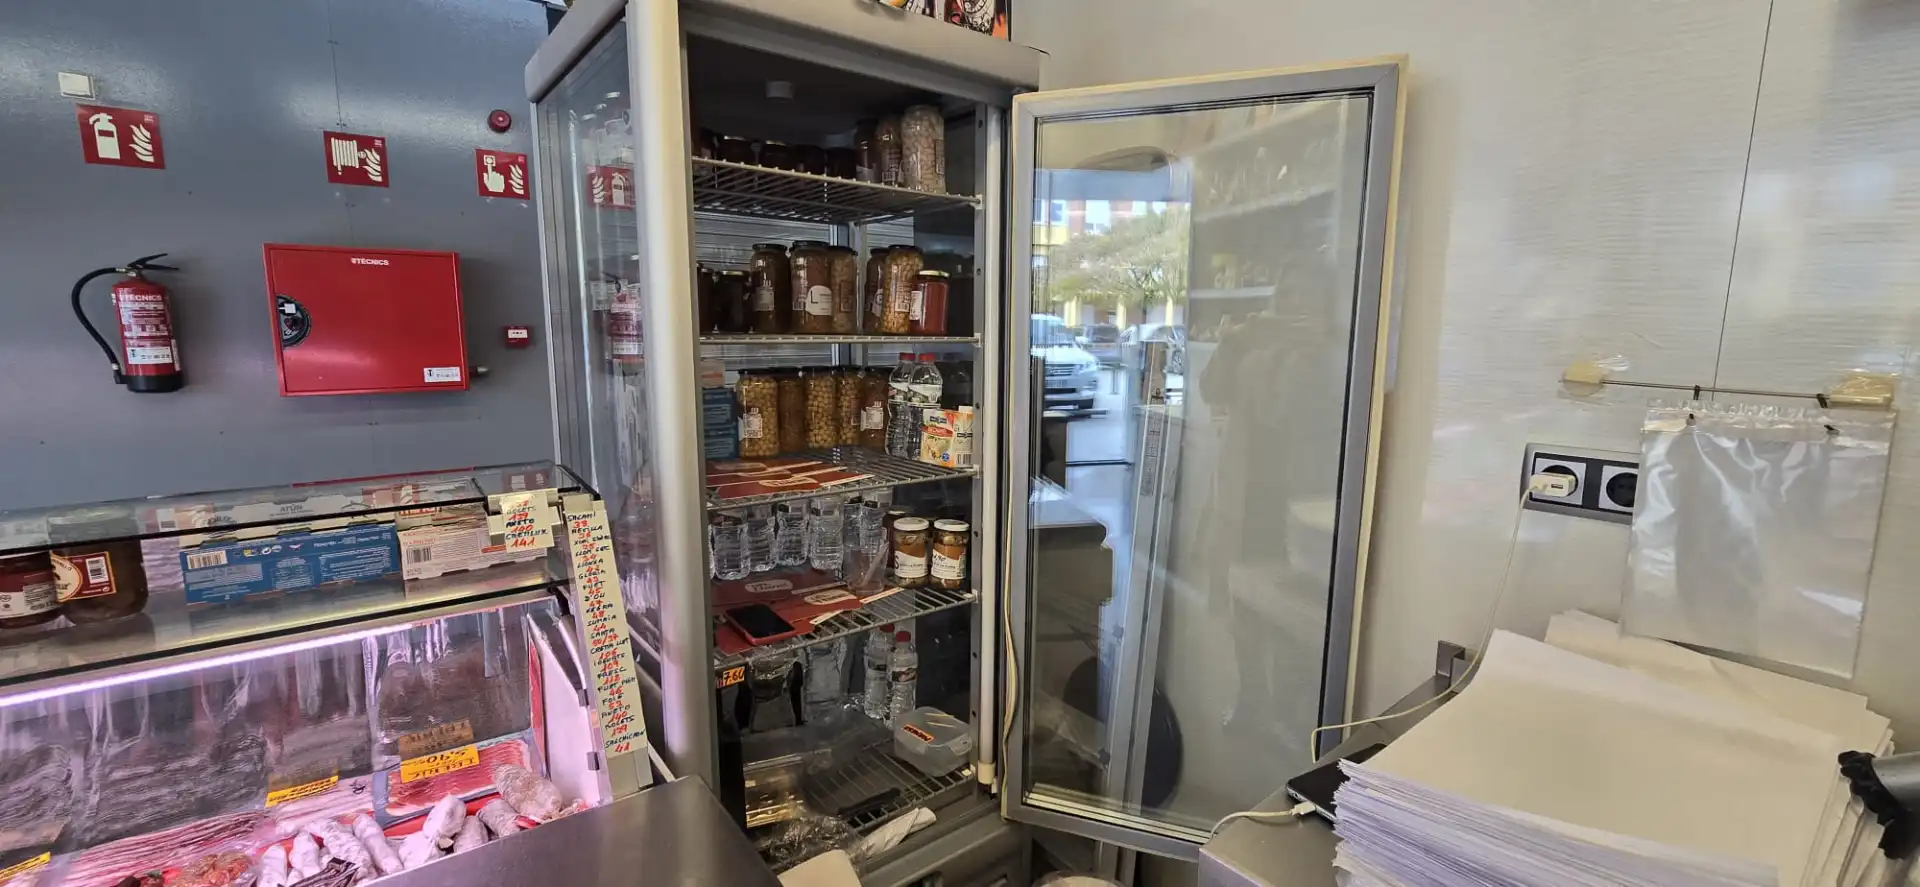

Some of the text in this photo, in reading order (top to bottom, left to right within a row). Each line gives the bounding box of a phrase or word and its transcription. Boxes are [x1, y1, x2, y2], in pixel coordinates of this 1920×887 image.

[511, 537, 535, 548] 141
[578, 570, 606, 580] GLORIA
[583, 580, 606, 590] FUET
